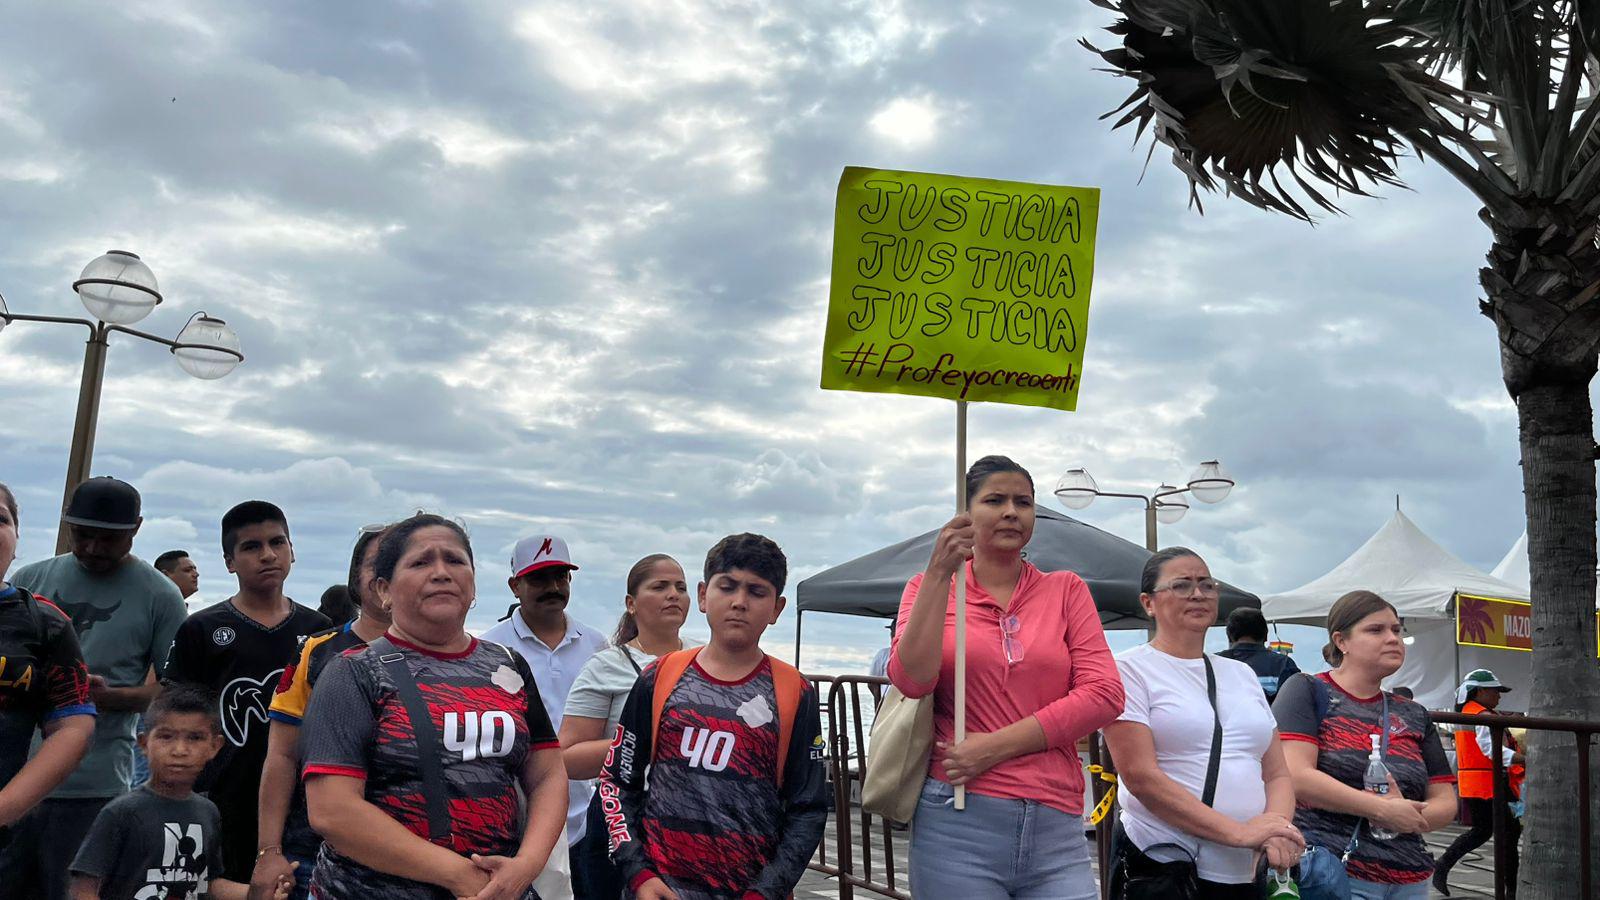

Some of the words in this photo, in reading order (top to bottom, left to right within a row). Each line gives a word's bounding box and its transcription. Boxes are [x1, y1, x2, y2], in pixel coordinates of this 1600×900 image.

[858, 179, 1081, 244] JUSTICIA
[857, 231, 1076, 299] JUSTICIA
[847, 284, 1077, 353] JUSTICIA
[443, 710, 515, 762] 40
[680, 726, 736, 773] 40
